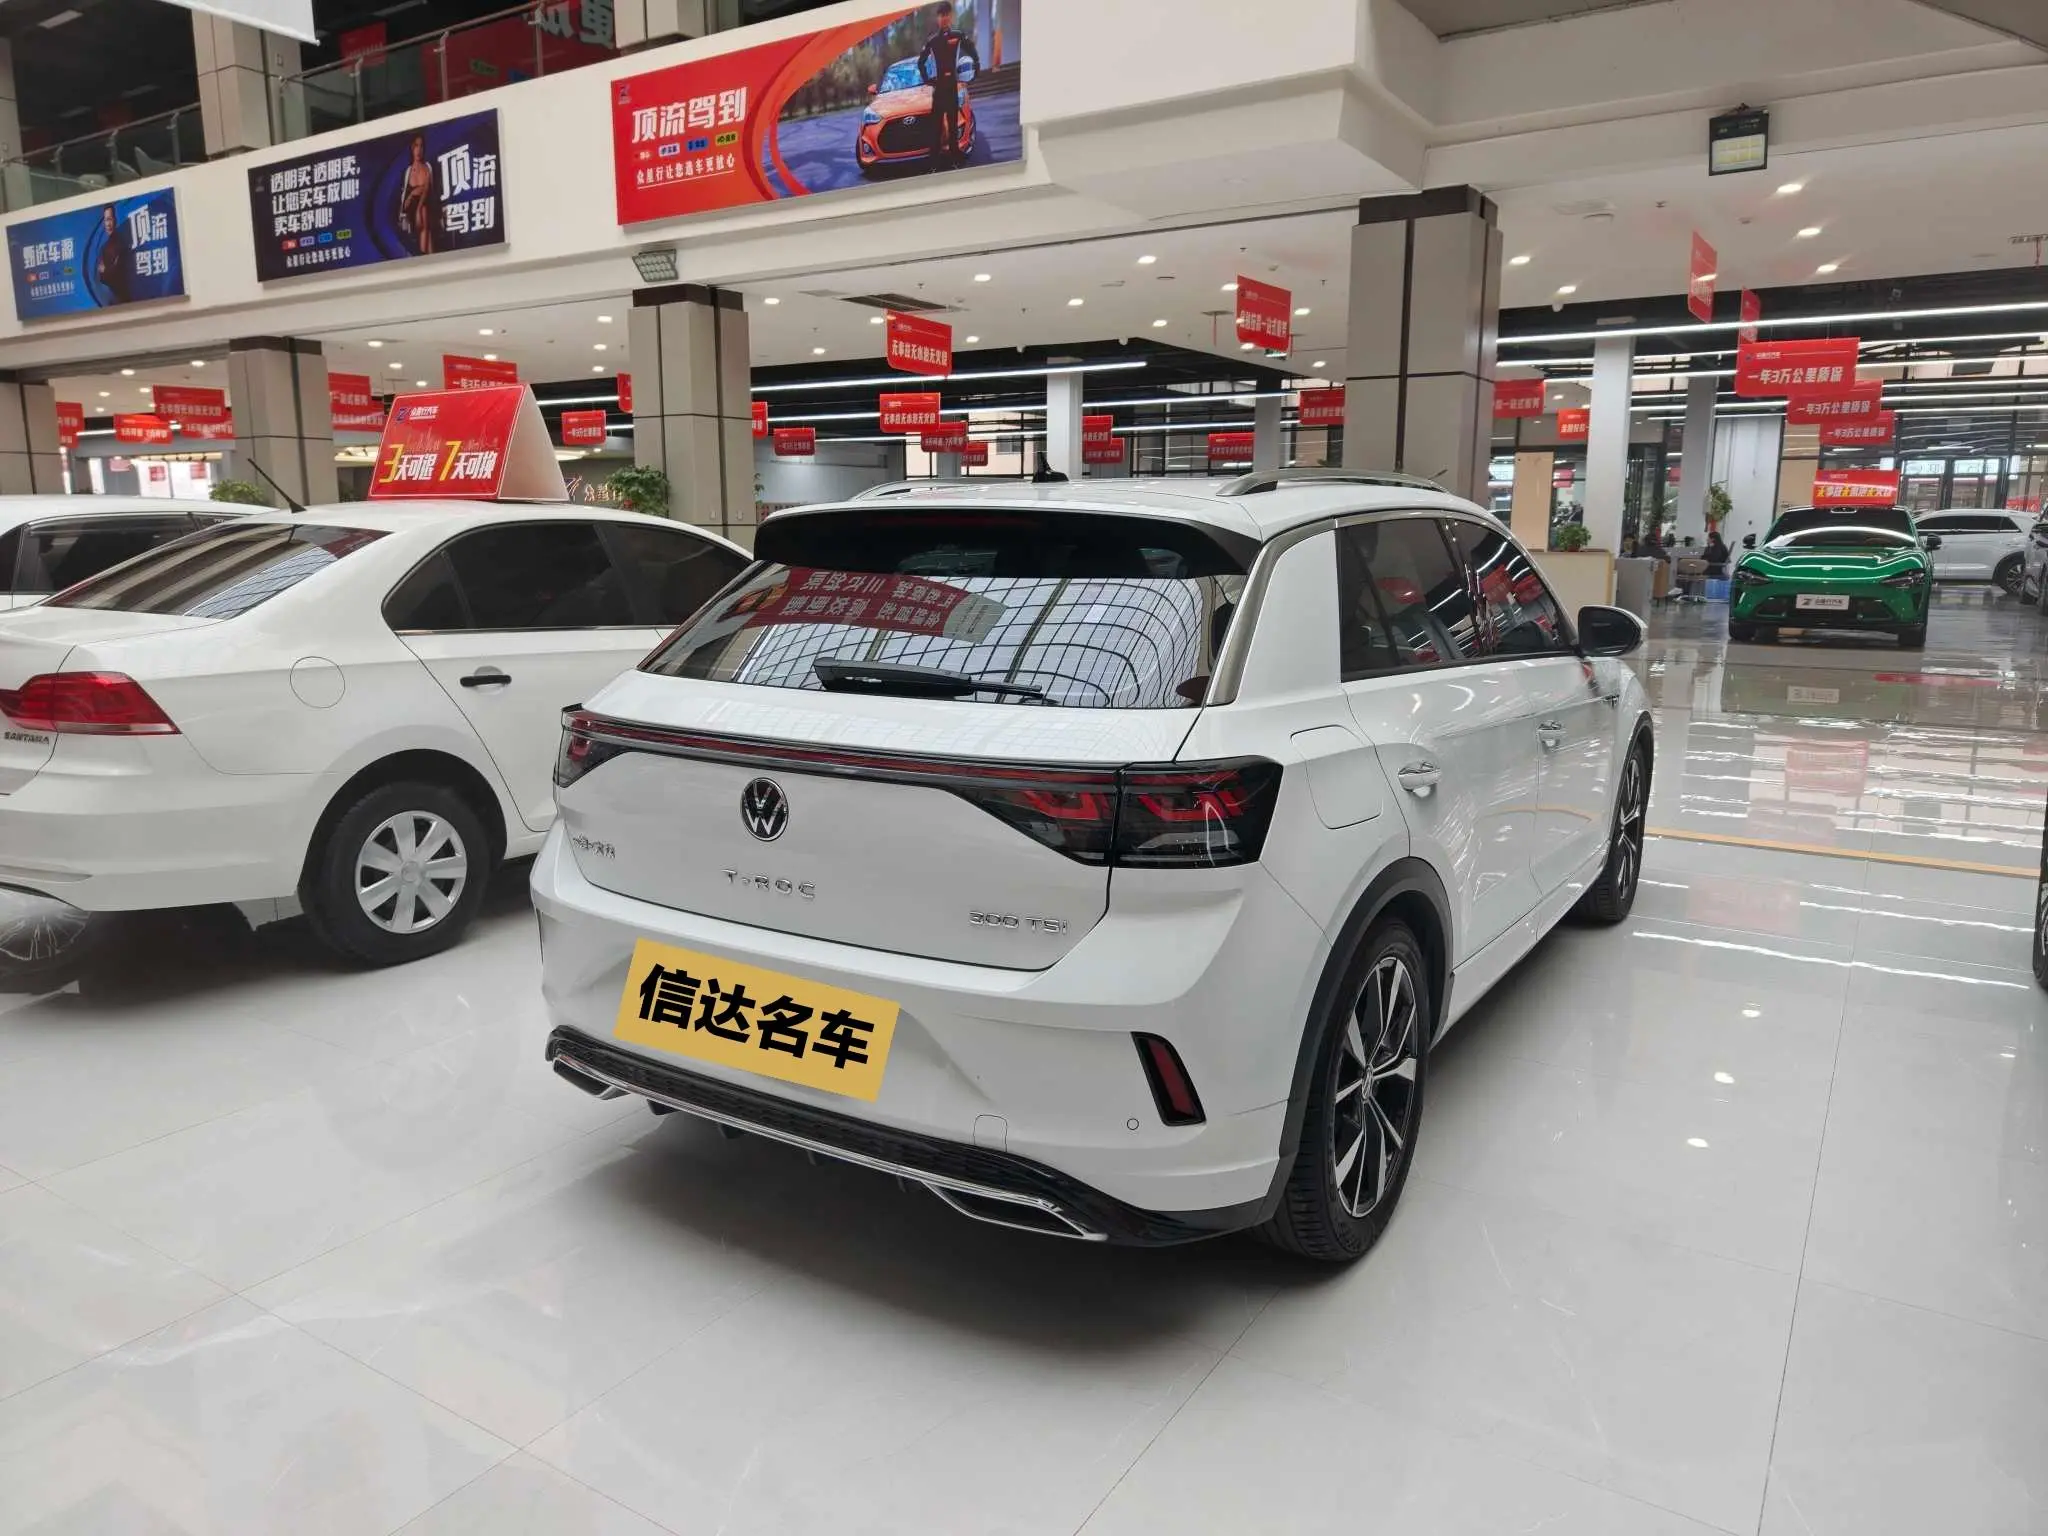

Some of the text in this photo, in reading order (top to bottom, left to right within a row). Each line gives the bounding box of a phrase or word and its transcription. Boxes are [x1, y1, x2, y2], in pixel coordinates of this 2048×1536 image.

[632, 87, 747, 143] 顶流驾到
[271, 165, 312, 193] 透明买
[437, 144, 497, 201] 顶流
[128, 204, 168, 249] 顶流
[442, 196, 495, 234] 驾到
[23, 238, 74, 269] 甄选车源
[136, 247, 168, 276] 驾到
[1748, 366, 1844, 384] 一年3万公里质保
[1798, 401, 1870, 415] 一年3万公里质保
[1827, 427, 1887, 437] 一年3万公里质保
[379, 440, 499, 484] 3天可退 7天可换
[969, 910, 1068, 935] 300 TSI
